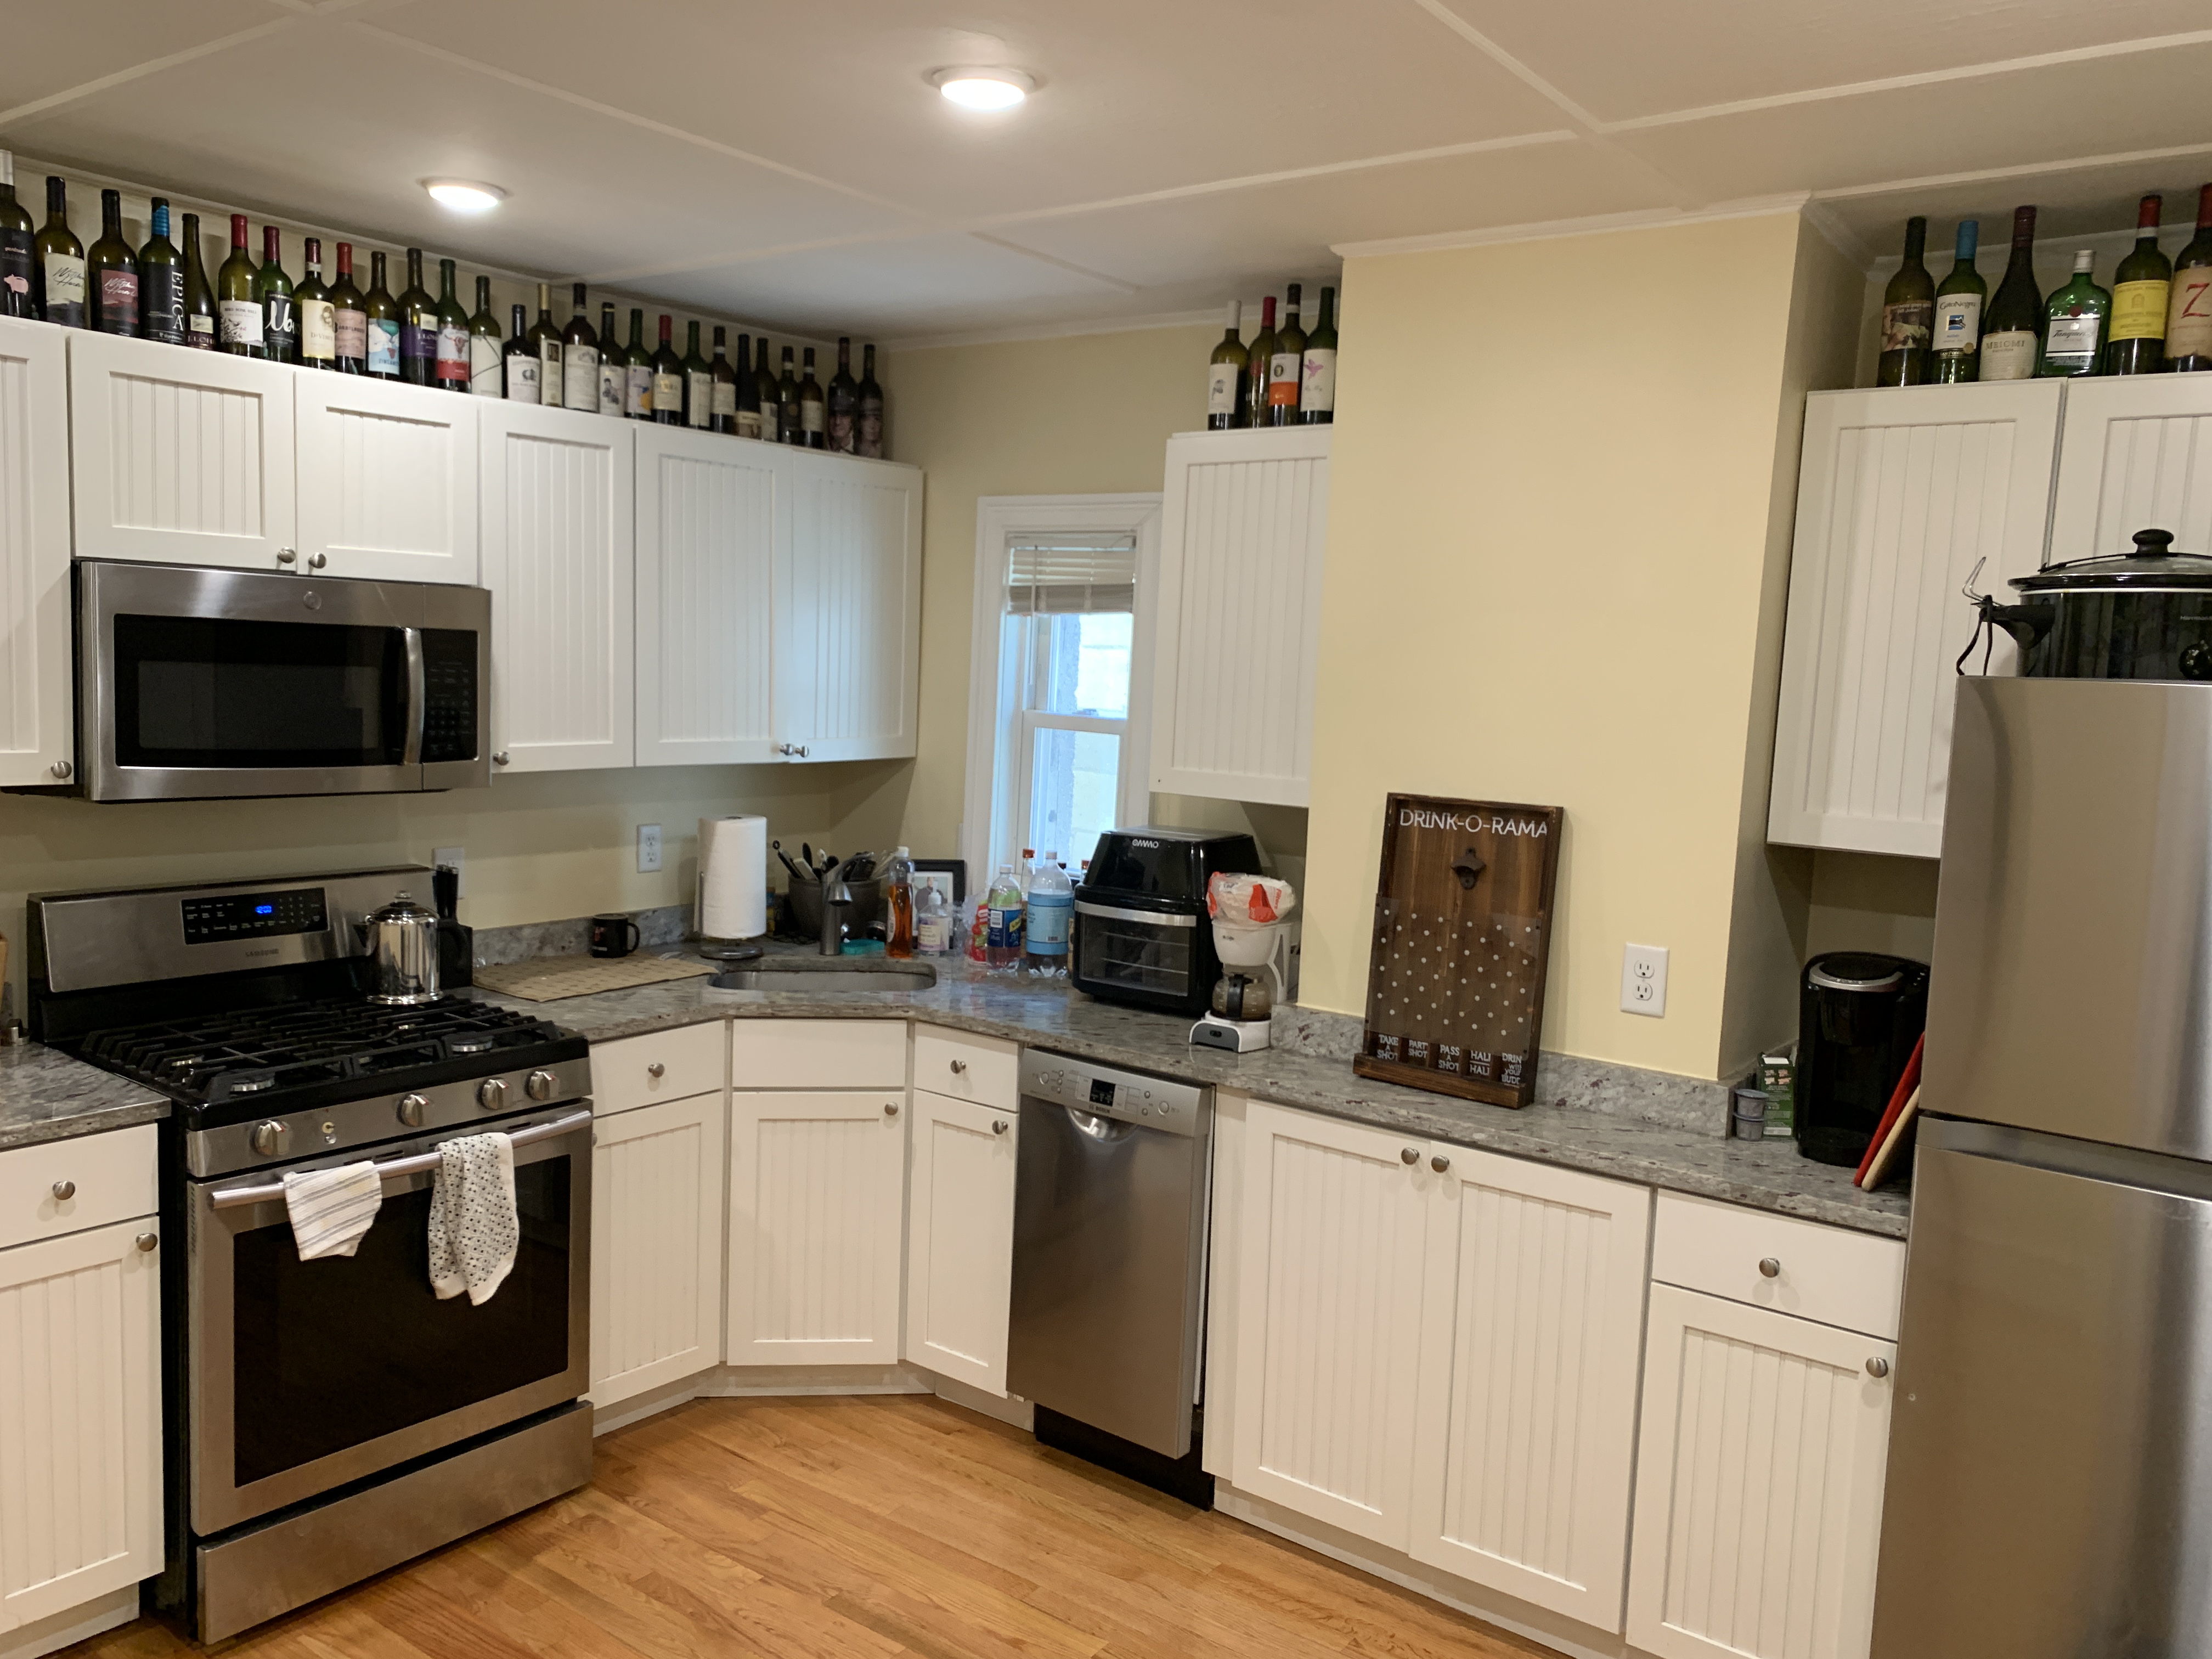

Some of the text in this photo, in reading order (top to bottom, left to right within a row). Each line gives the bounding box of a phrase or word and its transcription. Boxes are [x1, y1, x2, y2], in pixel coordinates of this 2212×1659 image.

[172, 271, 183, 331] EPICA
[194, 336, 213, 344] LOH
[1985, 340, 2025, 350] MEIOMI
[1400, 809, 1547, 838] DRINK-O-RAMA
[1378, 1034, 1398, 1046] TAKE
[1377, 1050, 1398, 1061] SHOT
[1408, 1048, 1427, 1059] SHOT
[1440, 1045, 1460, 1056] PASS
[1502, 1052, 1522, 1063] DRIN
[1438, 1060, 1459, 1071] SHOT
